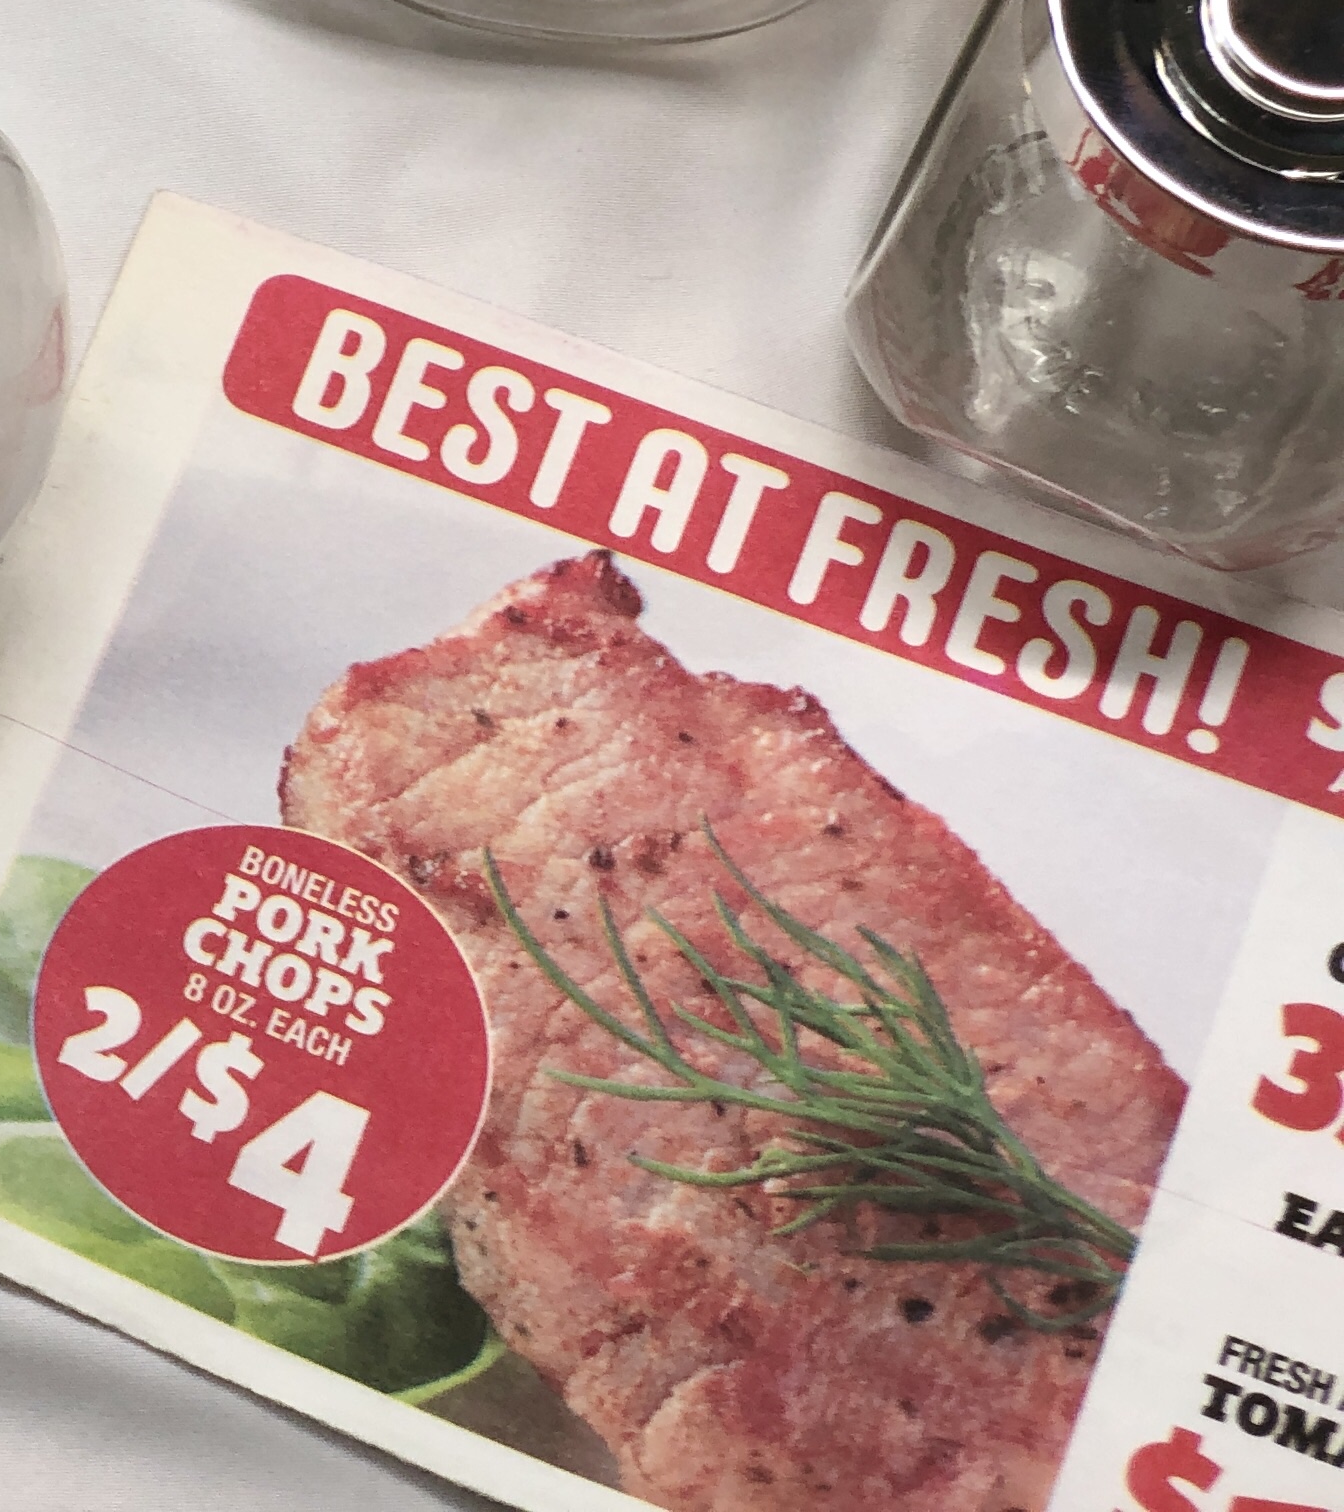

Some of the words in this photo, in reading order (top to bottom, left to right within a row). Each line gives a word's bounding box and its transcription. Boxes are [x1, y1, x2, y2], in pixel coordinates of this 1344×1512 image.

[291, 308, 614, 511] BEST
[610, 426, 792, 576] AT
[787, 493, 1250, 754] FRESH!
[213, 874, 393, 984] PORK
[238, 845, 400, 932] BONELESS
[183, 918, 392, 1035] CHOPS
[183, 973, 206, 1003] 8
[212, 984, 258, 1027] OZ.
[266, 1013, 353, 1066] EACH
[1217, 1334, 1337, 1405] FRESH
[1201, 1373, 1344, 1468] TOM
